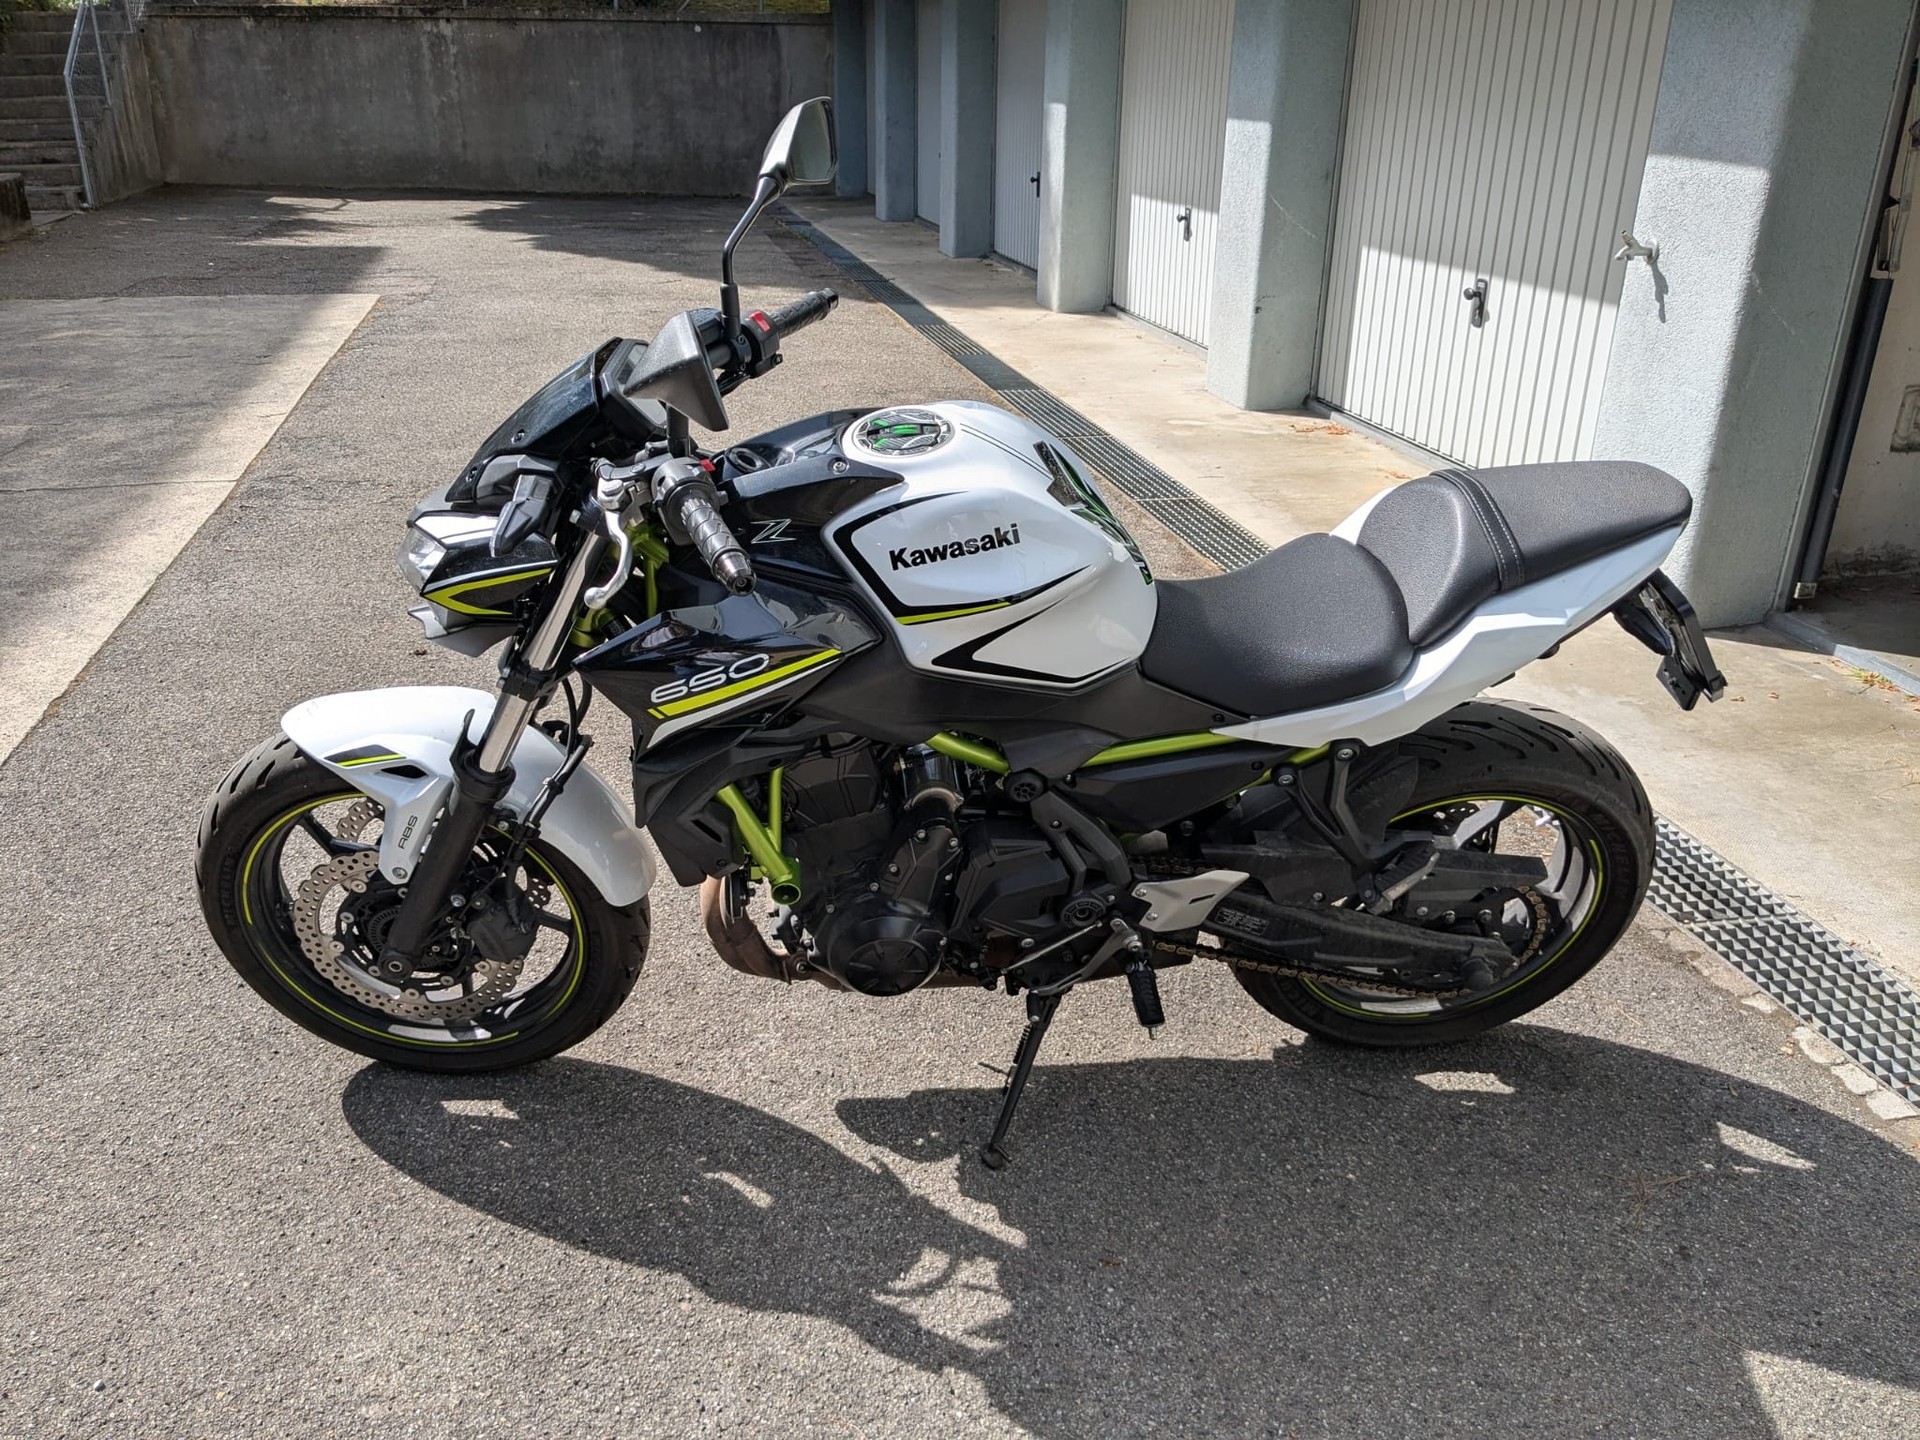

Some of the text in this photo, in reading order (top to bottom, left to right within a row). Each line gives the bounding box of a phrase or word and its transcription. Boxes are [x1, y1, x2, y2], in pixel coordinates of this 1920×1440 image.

[750, 518, 797, 544] Z
[889, 523, 1021, 571] Kawasaki
[650, 653, 770, 703] 650
[398, 815, 418, 849] ABS
